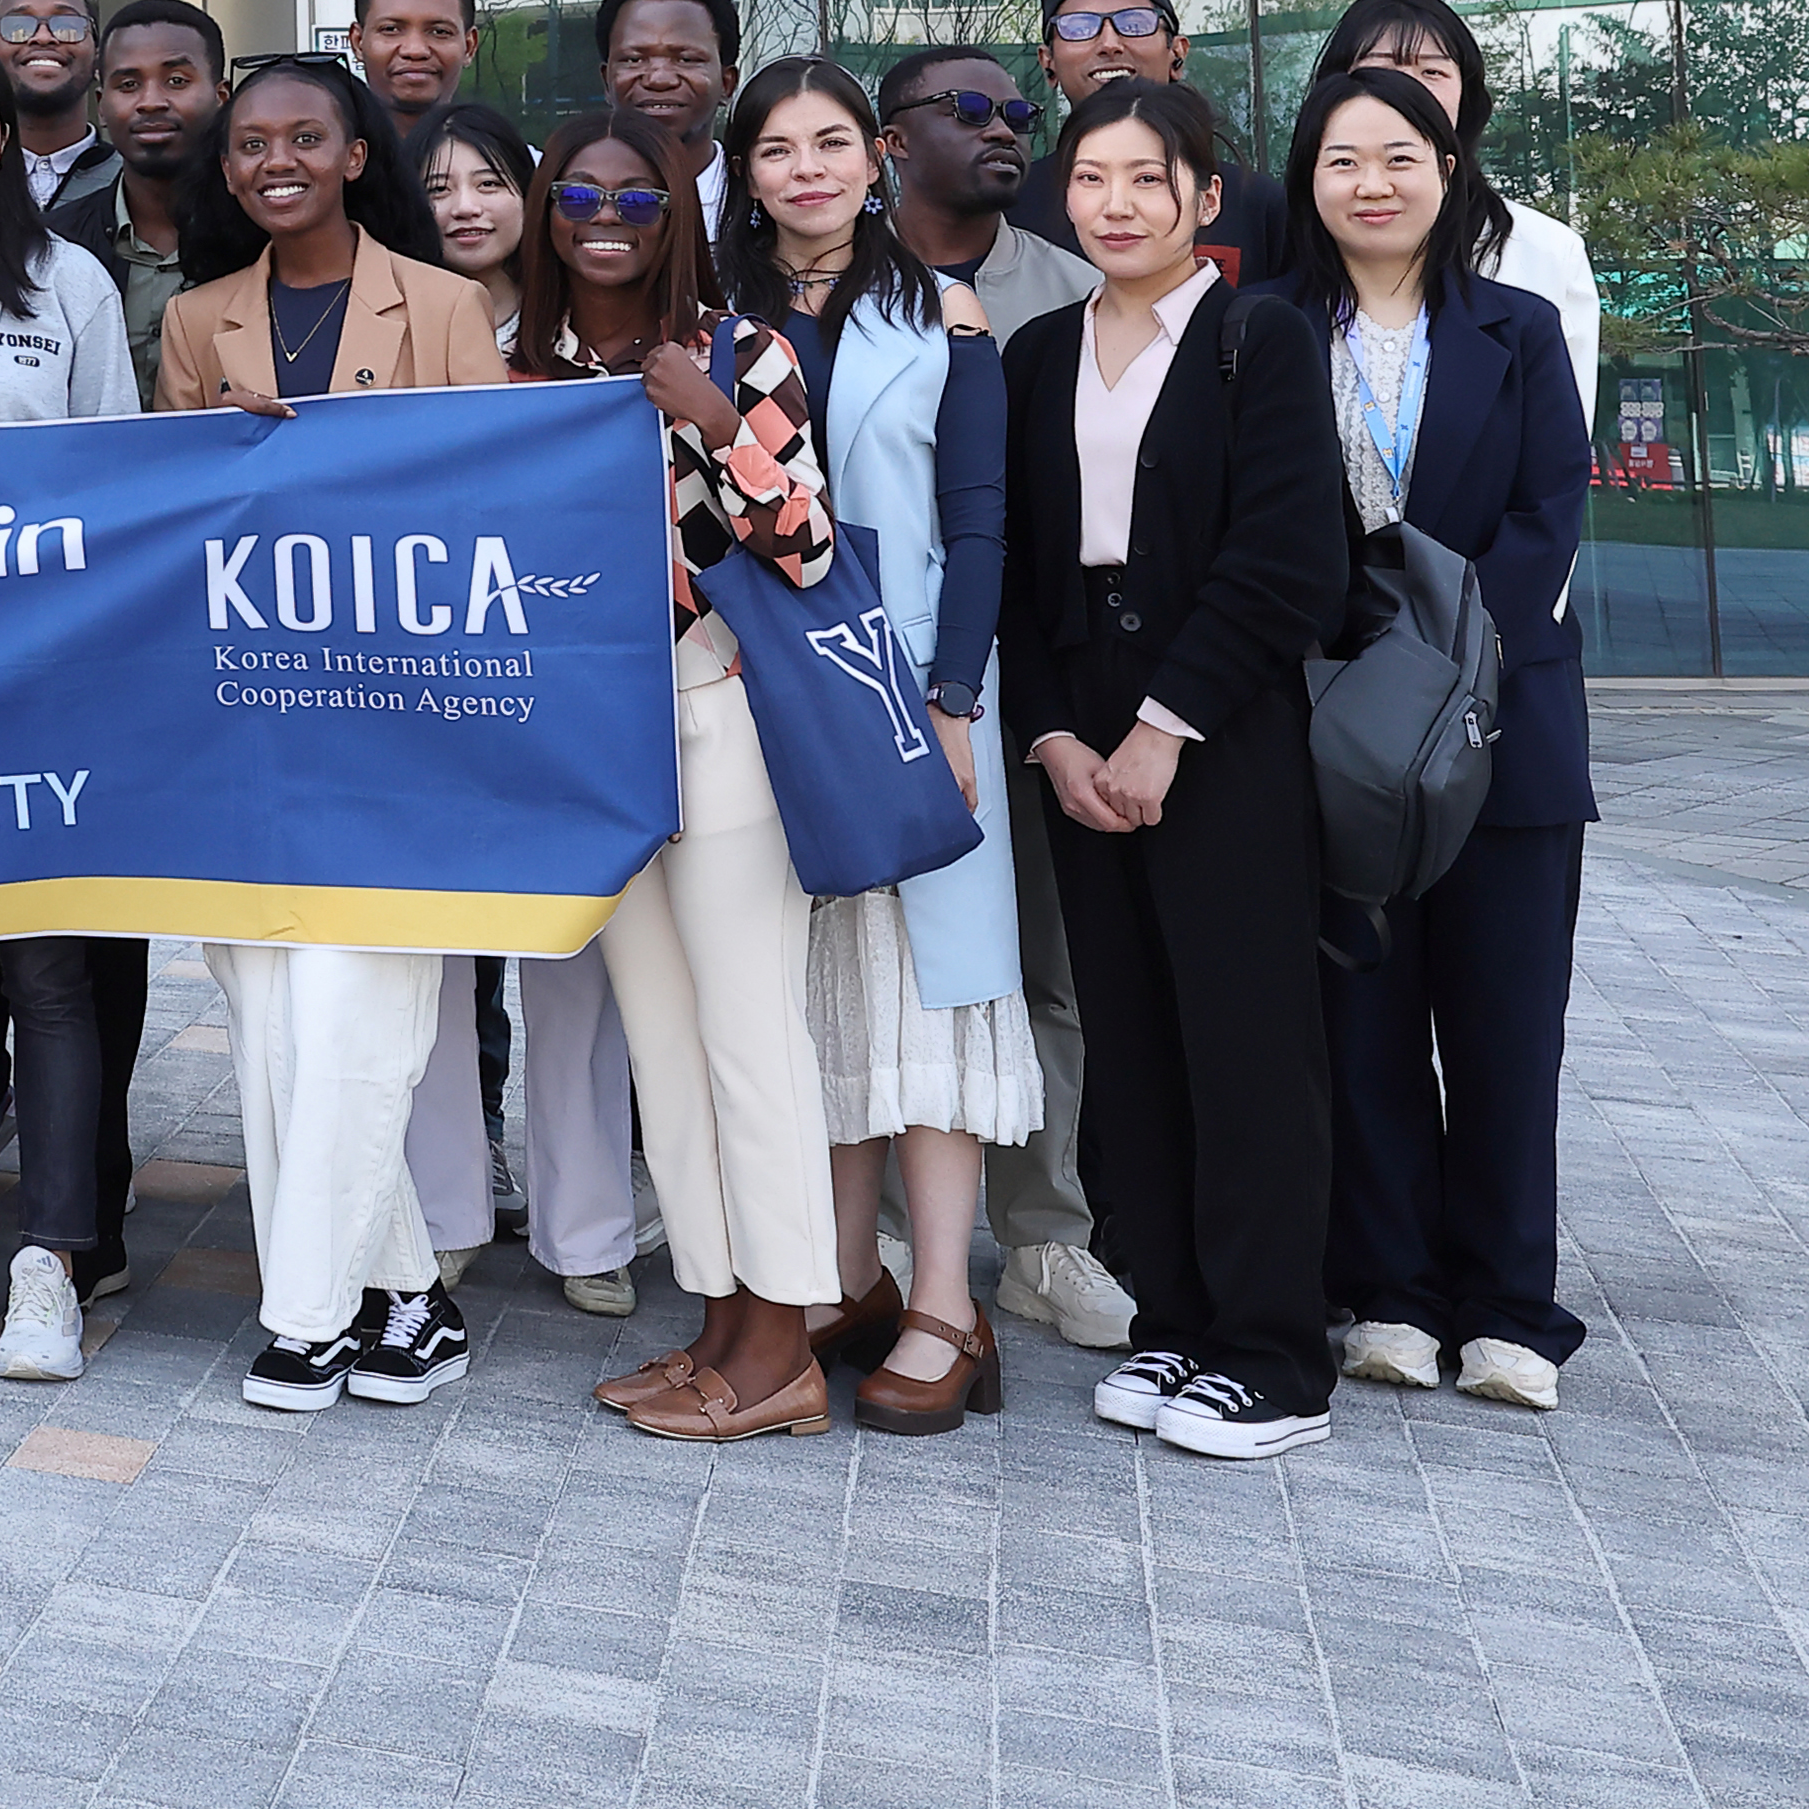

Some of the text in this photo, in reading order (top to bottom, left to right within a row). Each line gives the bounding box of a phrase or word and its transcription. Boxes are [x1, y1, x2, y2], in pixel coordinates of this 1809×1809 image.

[204, 533, 530, 636] KOICA
[214, 645, 533, 678] Korea International
[806, 606, 930, 763] Y
[216, 681, 535, 724] Cooperation Agency
